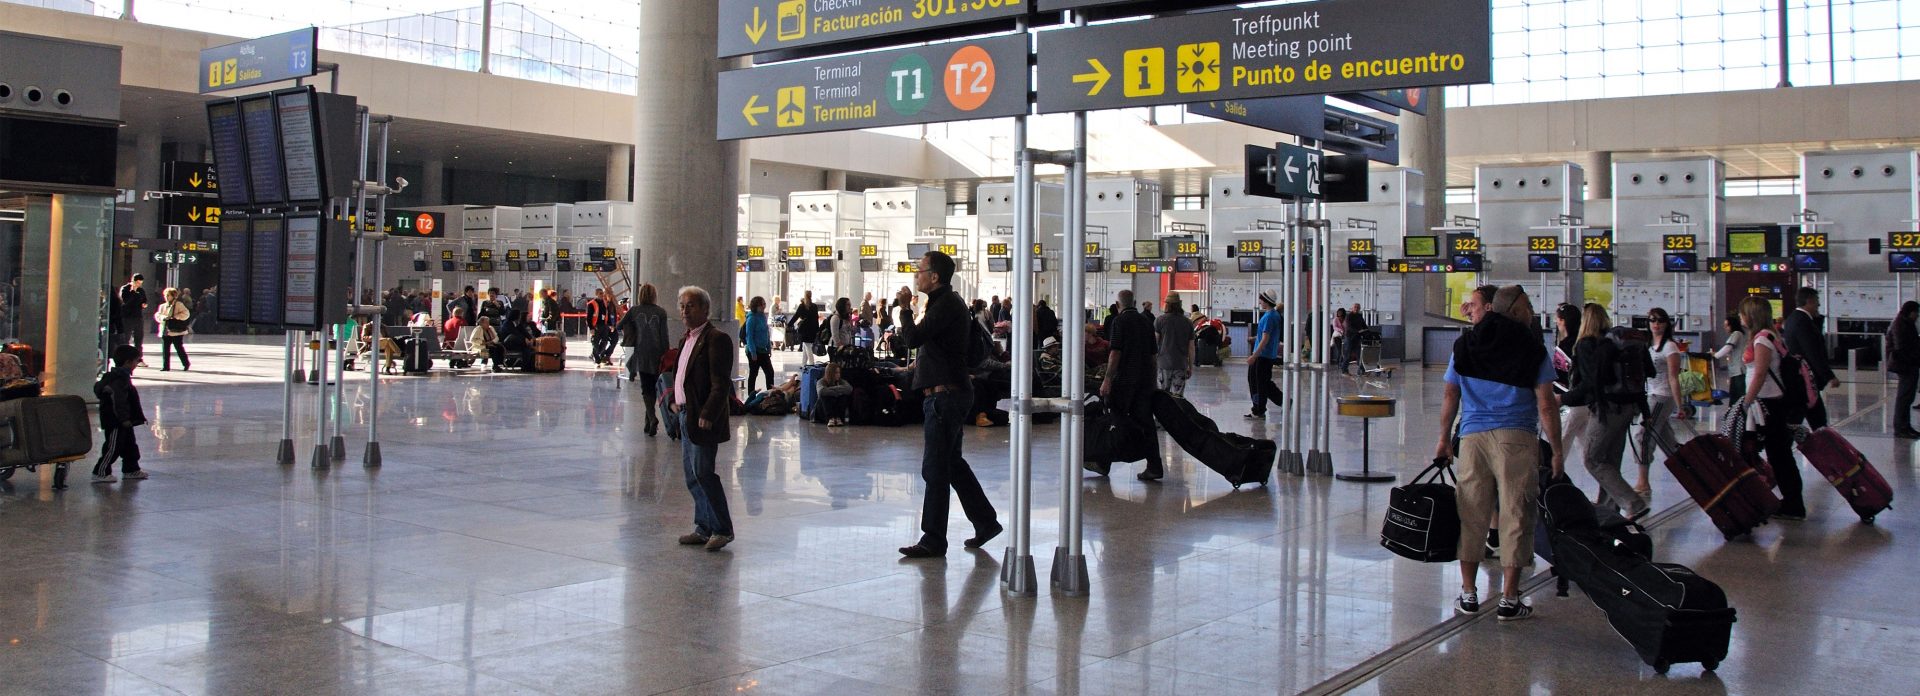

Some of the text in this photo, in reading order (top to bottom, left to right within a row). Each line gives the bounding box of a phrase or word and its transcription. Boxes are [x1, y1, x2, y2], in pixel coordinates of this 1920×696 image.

[813, 6, 903, 34] Facturación
[1232, 11, 1320, 36] Treffpunkt
[1232, 32, 1352, 60] Meeting point
[292, 51, 307, 69] T3
[240, 69, 262, 80] Salidas
[814, 61, 862, 81] Terminal
[1232, 52, 1465, 87] Punto de encuentro
[813, 61, 988, 122] Terminal T1 T2
[814, 81, 861, 101] Terminal
[1224, 101, 1247, 117] Salida
[397, 216, 410, 228] T1
[418, 218, 432, 230] T2
[1351, 240, 1371, 250] 321
[1455, 239, 1478, 250] 322
[1531, 238, 1555, 249] 323
[1584, 238, 1610, 249] 324
[1667, 237, 1693, 248] 325
[1796, 235, 1825, 248] 326
[1893, 234, 1920, 246] 327
[749, 247, 763, 256] 310
[788, 247, 801, 256] 311
[816, 247, 830, 255] 312
[861, 246, 875, 255] 313
[940, 245, 955, 255] 314
[989, 244, 1005, 254] 315
[1086, 244, 1096, 253] 17
[1178, 243, 1197, 253] 318
[1240, 241, 1260, 252] 319
